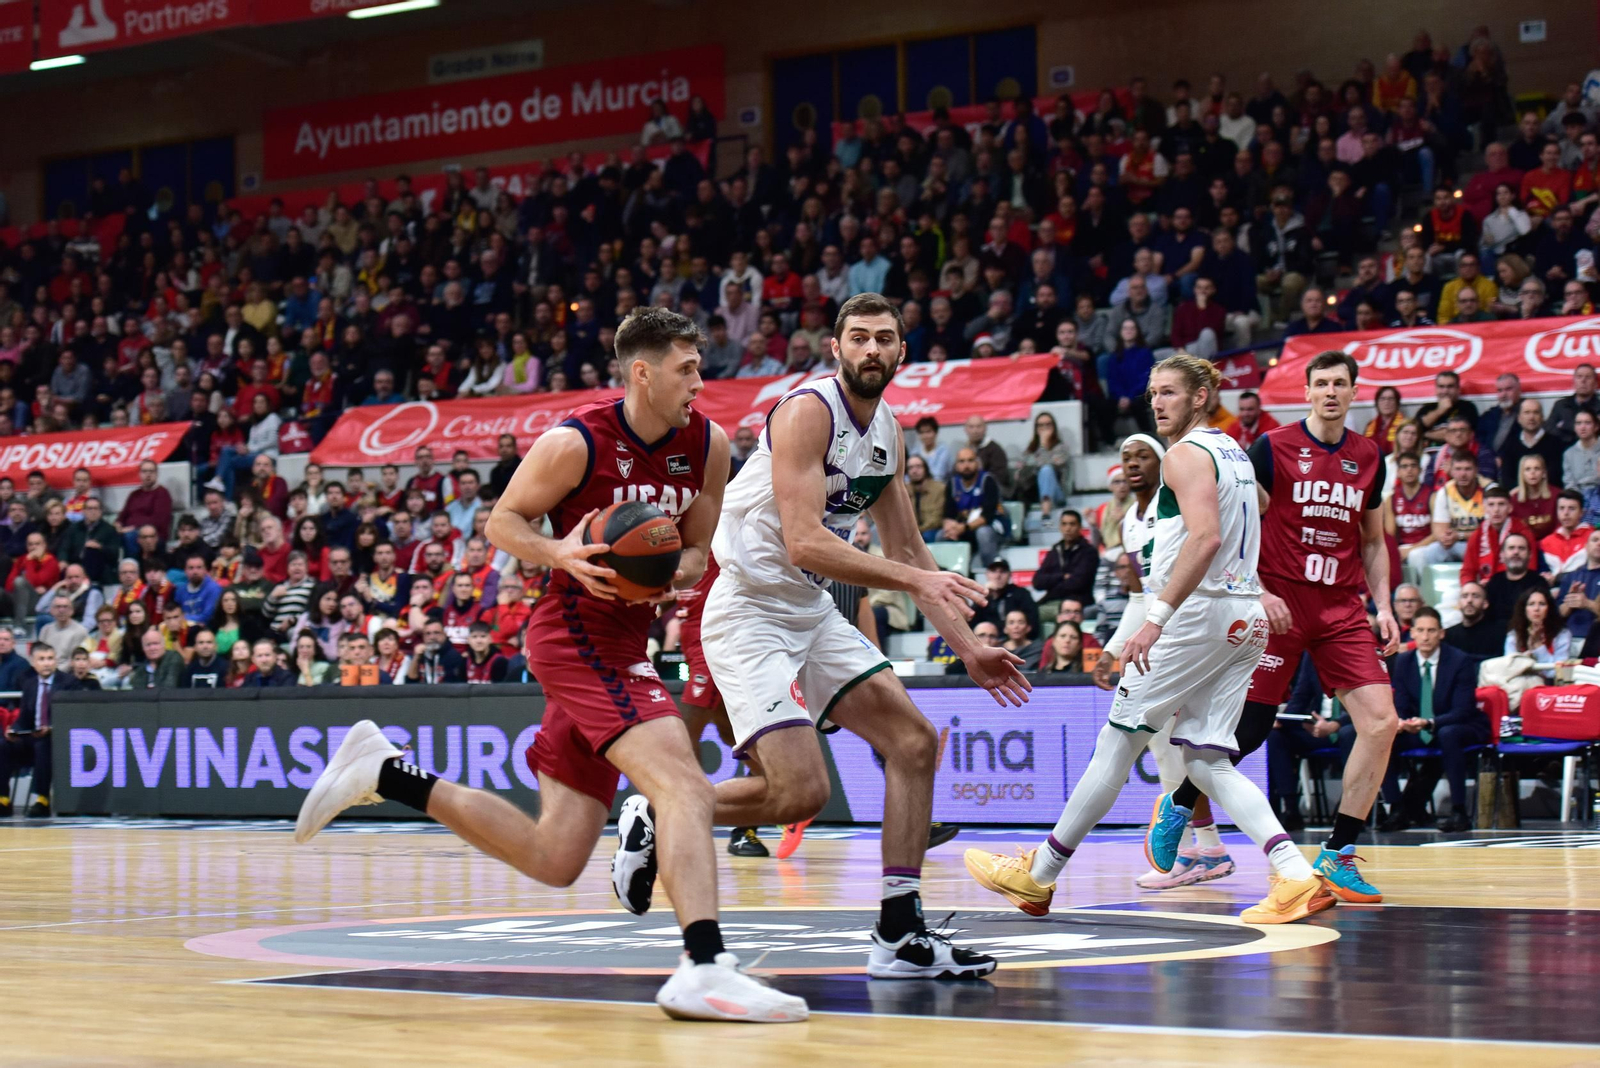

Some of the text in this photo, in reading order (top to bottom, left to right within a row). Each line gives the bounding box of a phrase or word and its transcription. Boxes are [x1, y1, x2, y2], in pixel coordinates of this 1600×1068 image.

[124, 1, 229, 37] Partners
[294, 69, 691, 158] Ayuntamiento de Murcia
[1357, 342, 1466, 369] Juver
[1541, 332, 1600, 358] Juv
[442, 414, 518, 438] Costa
[1292, 480, 1364, 513] UCAM
[1302, 505, 1350, 523] MURCIA
[1238, 501, 1247, 560] 1
[1304, 553, 1339, 586] 00
[952, 780, 1035, 806] seguros
